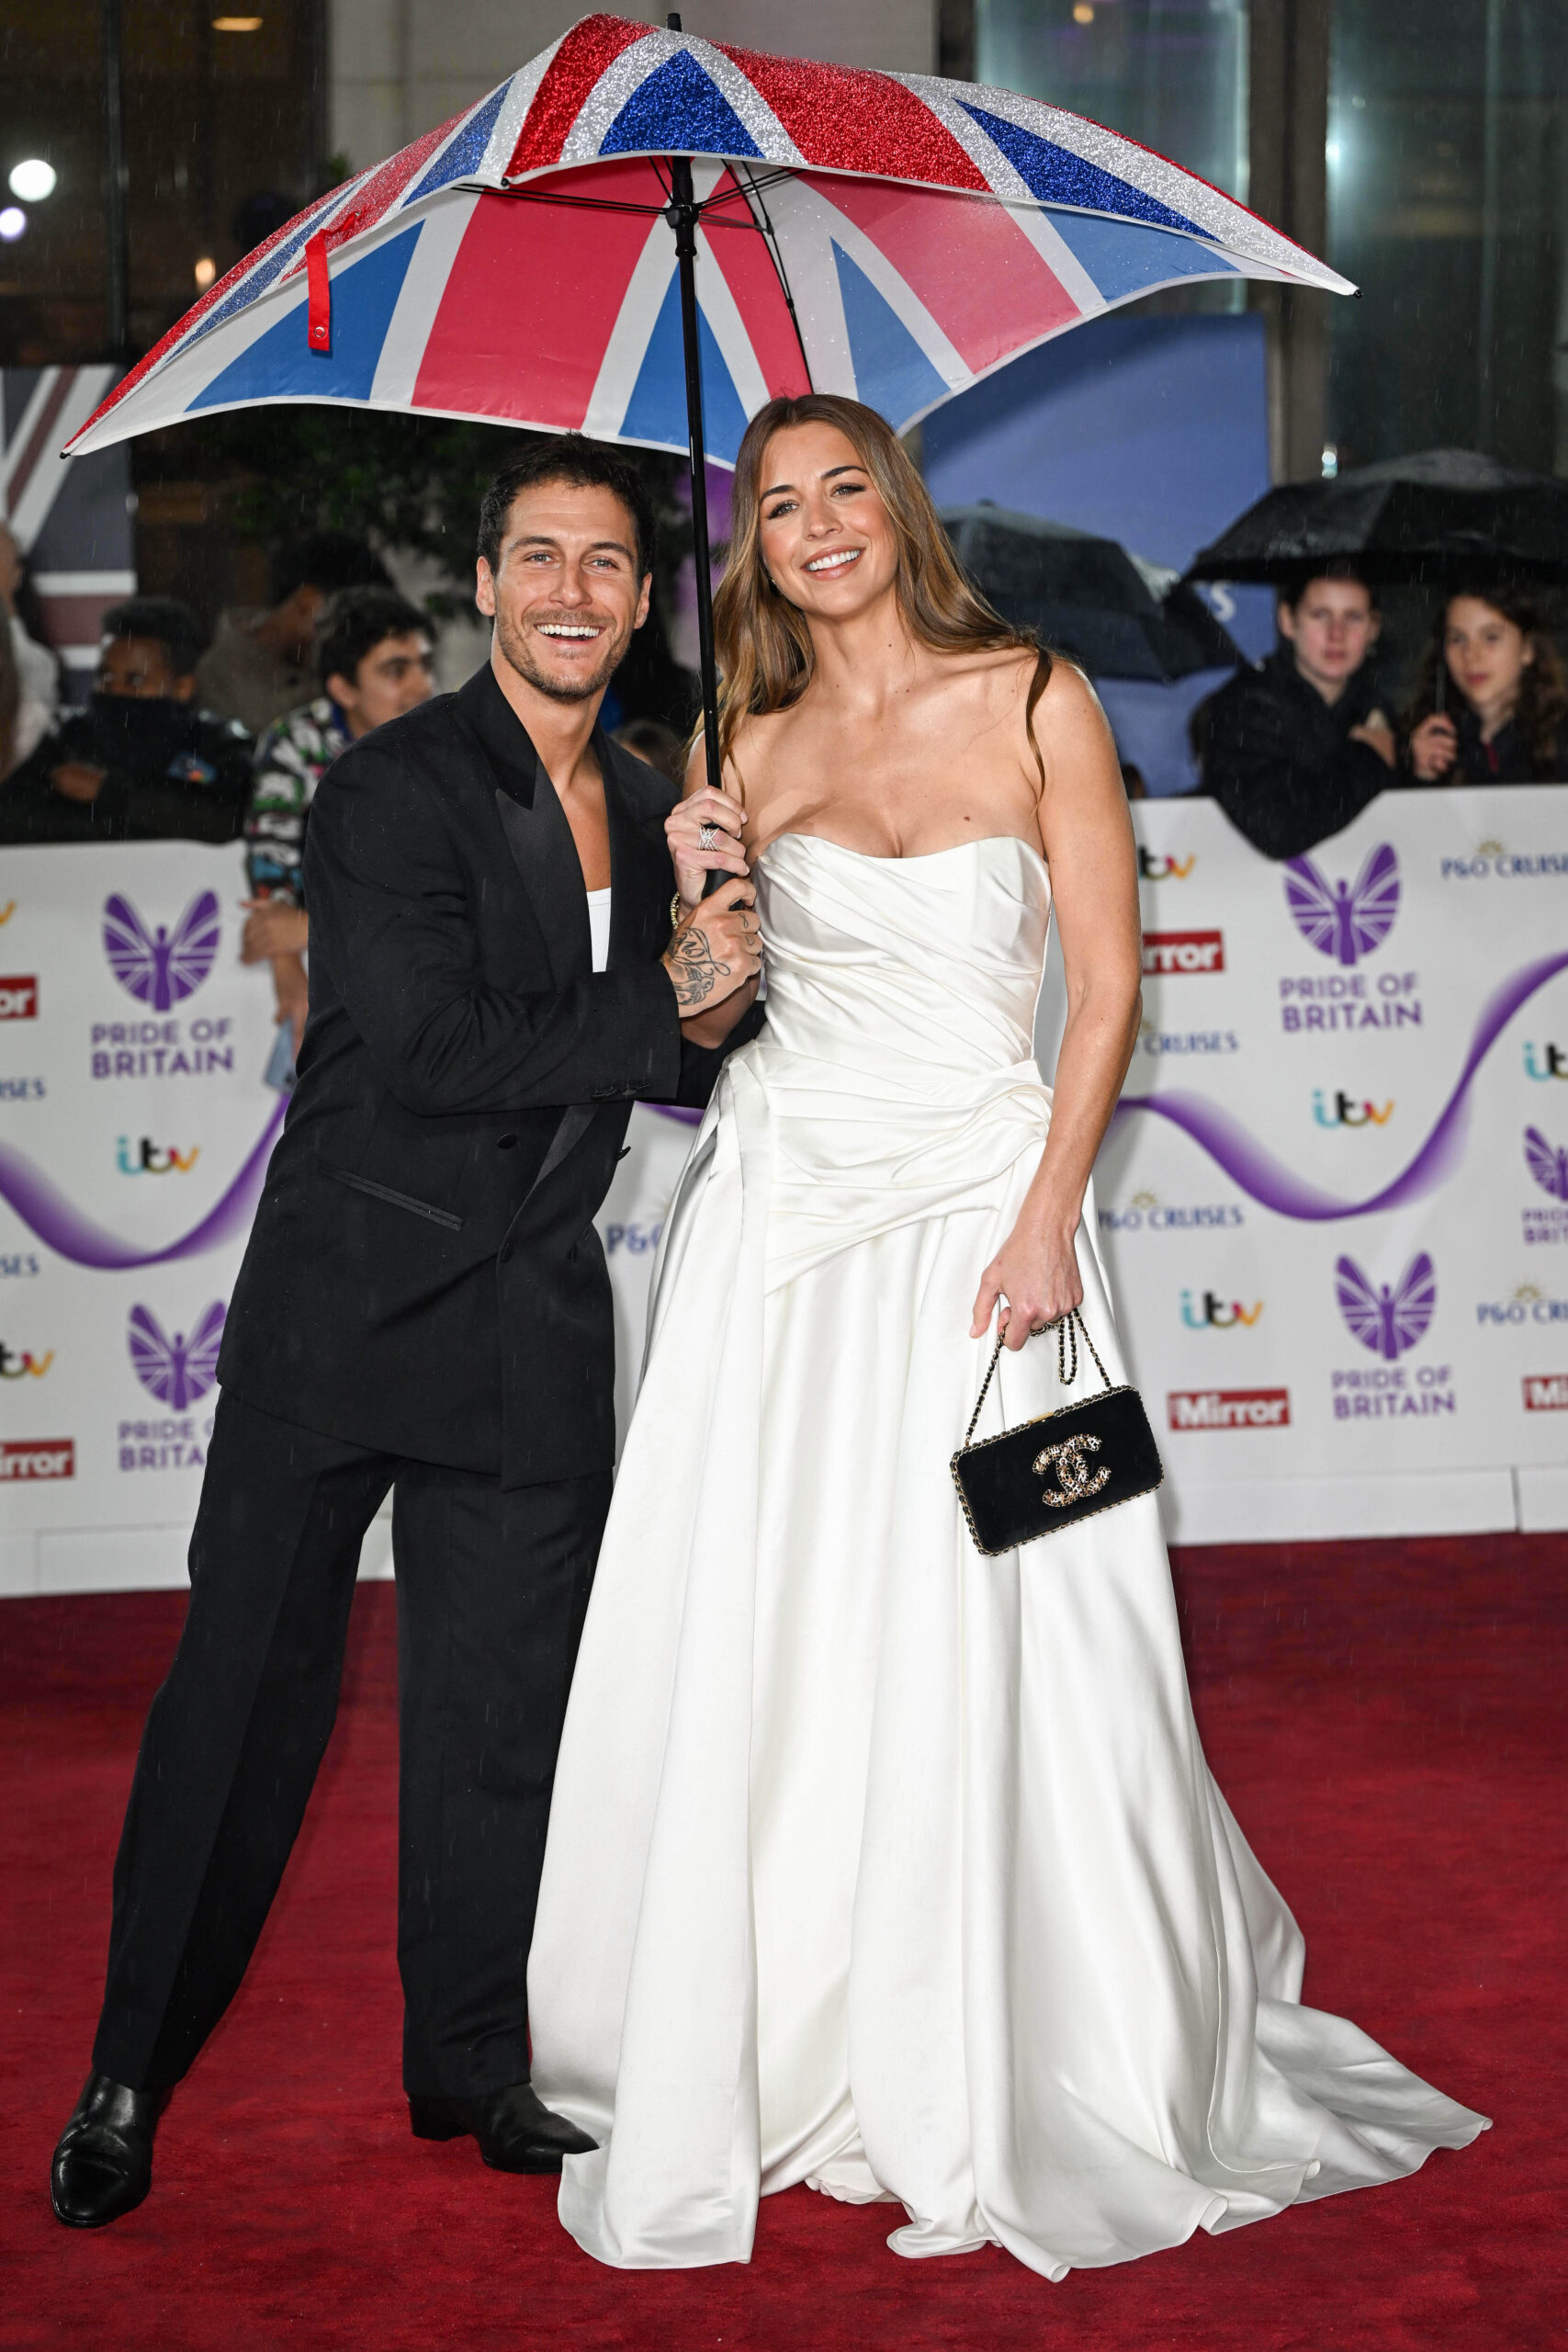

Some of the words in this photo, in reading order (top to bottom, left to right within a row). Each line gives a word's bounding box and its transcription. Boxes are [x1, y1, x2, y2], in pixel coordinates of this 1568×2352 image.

[1138, 845, 1195, 880] tv
[1280, 974, 1366, 998] PRIDE
[1377, 971, 1418, 997] OF
[1282, 999, 1423, 1032] BRITAIN
[91, 1019, 179, 1046] PRIDE
[190, 1017, 232, 1043] OF
[1145, 1030, 1238, 1055] CRUISES
[91, 1045, 235, 1079] BRITAIN
[1522, 1041, 1568, 1082] it
[1314, 1089, 1393, 1128] itv
[116, 1136, 199, 1176] itv
[1148, 1204, 1244, 1229] CRUISES
[1180, 1289, 1263, 1329] itv
[0, 1340, 55, 1378] tv
[1331, 1367, 1404, 1389] PRIDE
[1416, 1365, 1450, 1388] OF
[1178, 1395, 1286, 1426] Mirror
[1334, 1390, 1455, 1419] BRITAIN
[118, 1419, 195, 1441] PRIDE
[119, 1443, 206, 1472] BRITA
